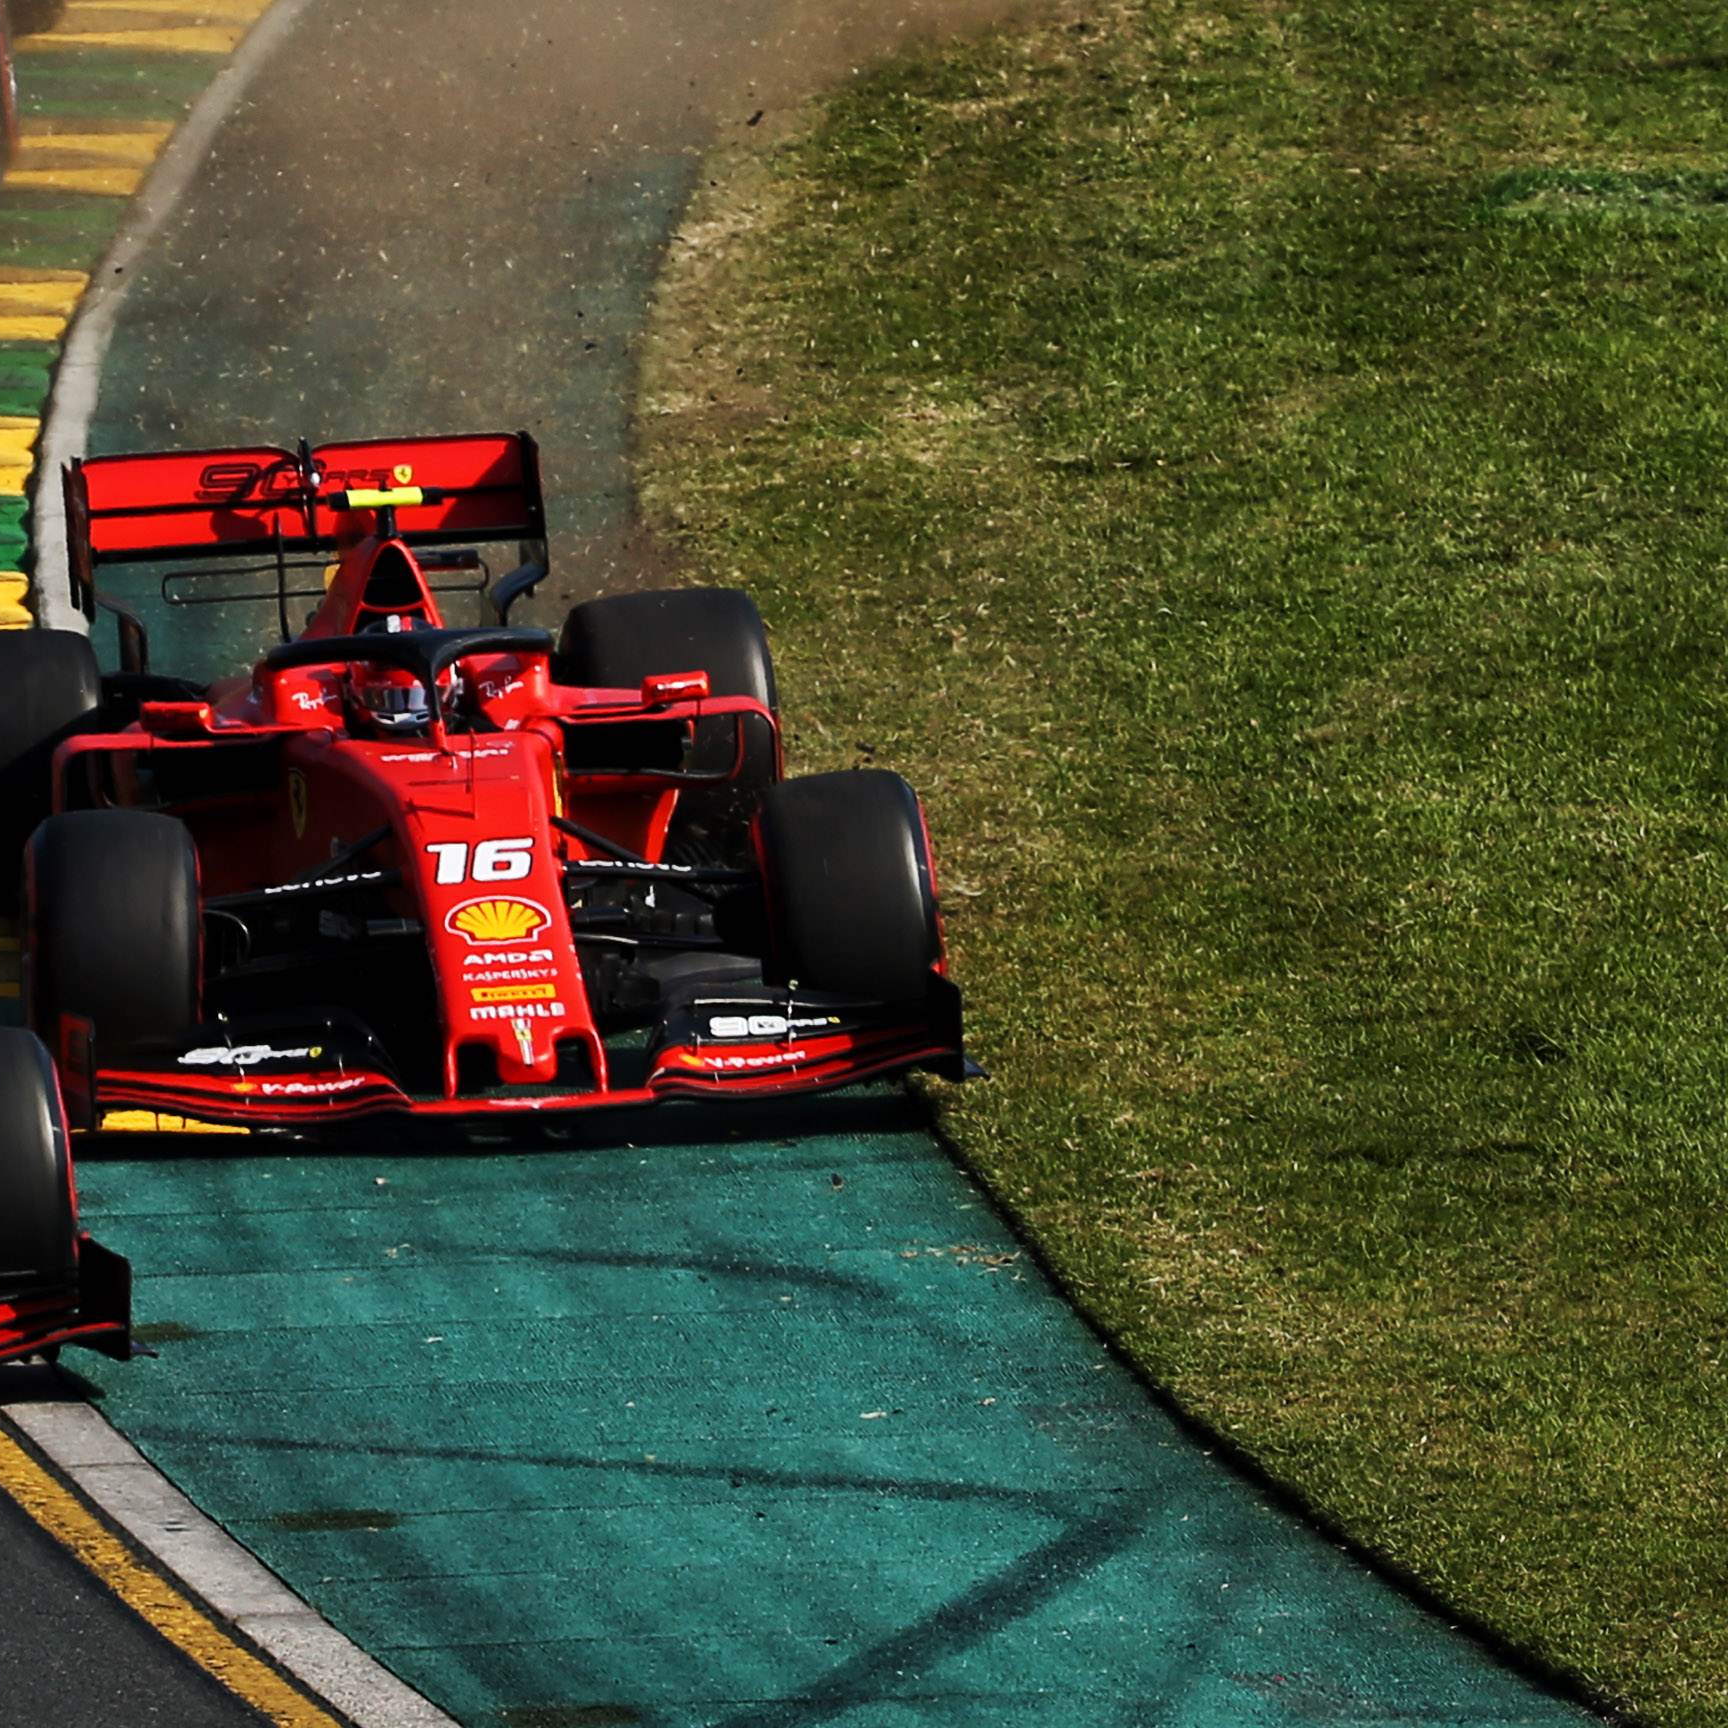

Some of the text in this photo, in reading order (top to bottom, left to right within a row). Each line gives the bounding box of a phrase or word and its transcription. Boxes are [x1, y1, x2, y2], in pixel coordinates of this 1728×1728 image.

[425, 837, 535, 885] 16
[470, 1003, 566, 1021] MAHLE
[704, 1050, 806, 1069] V-Power
